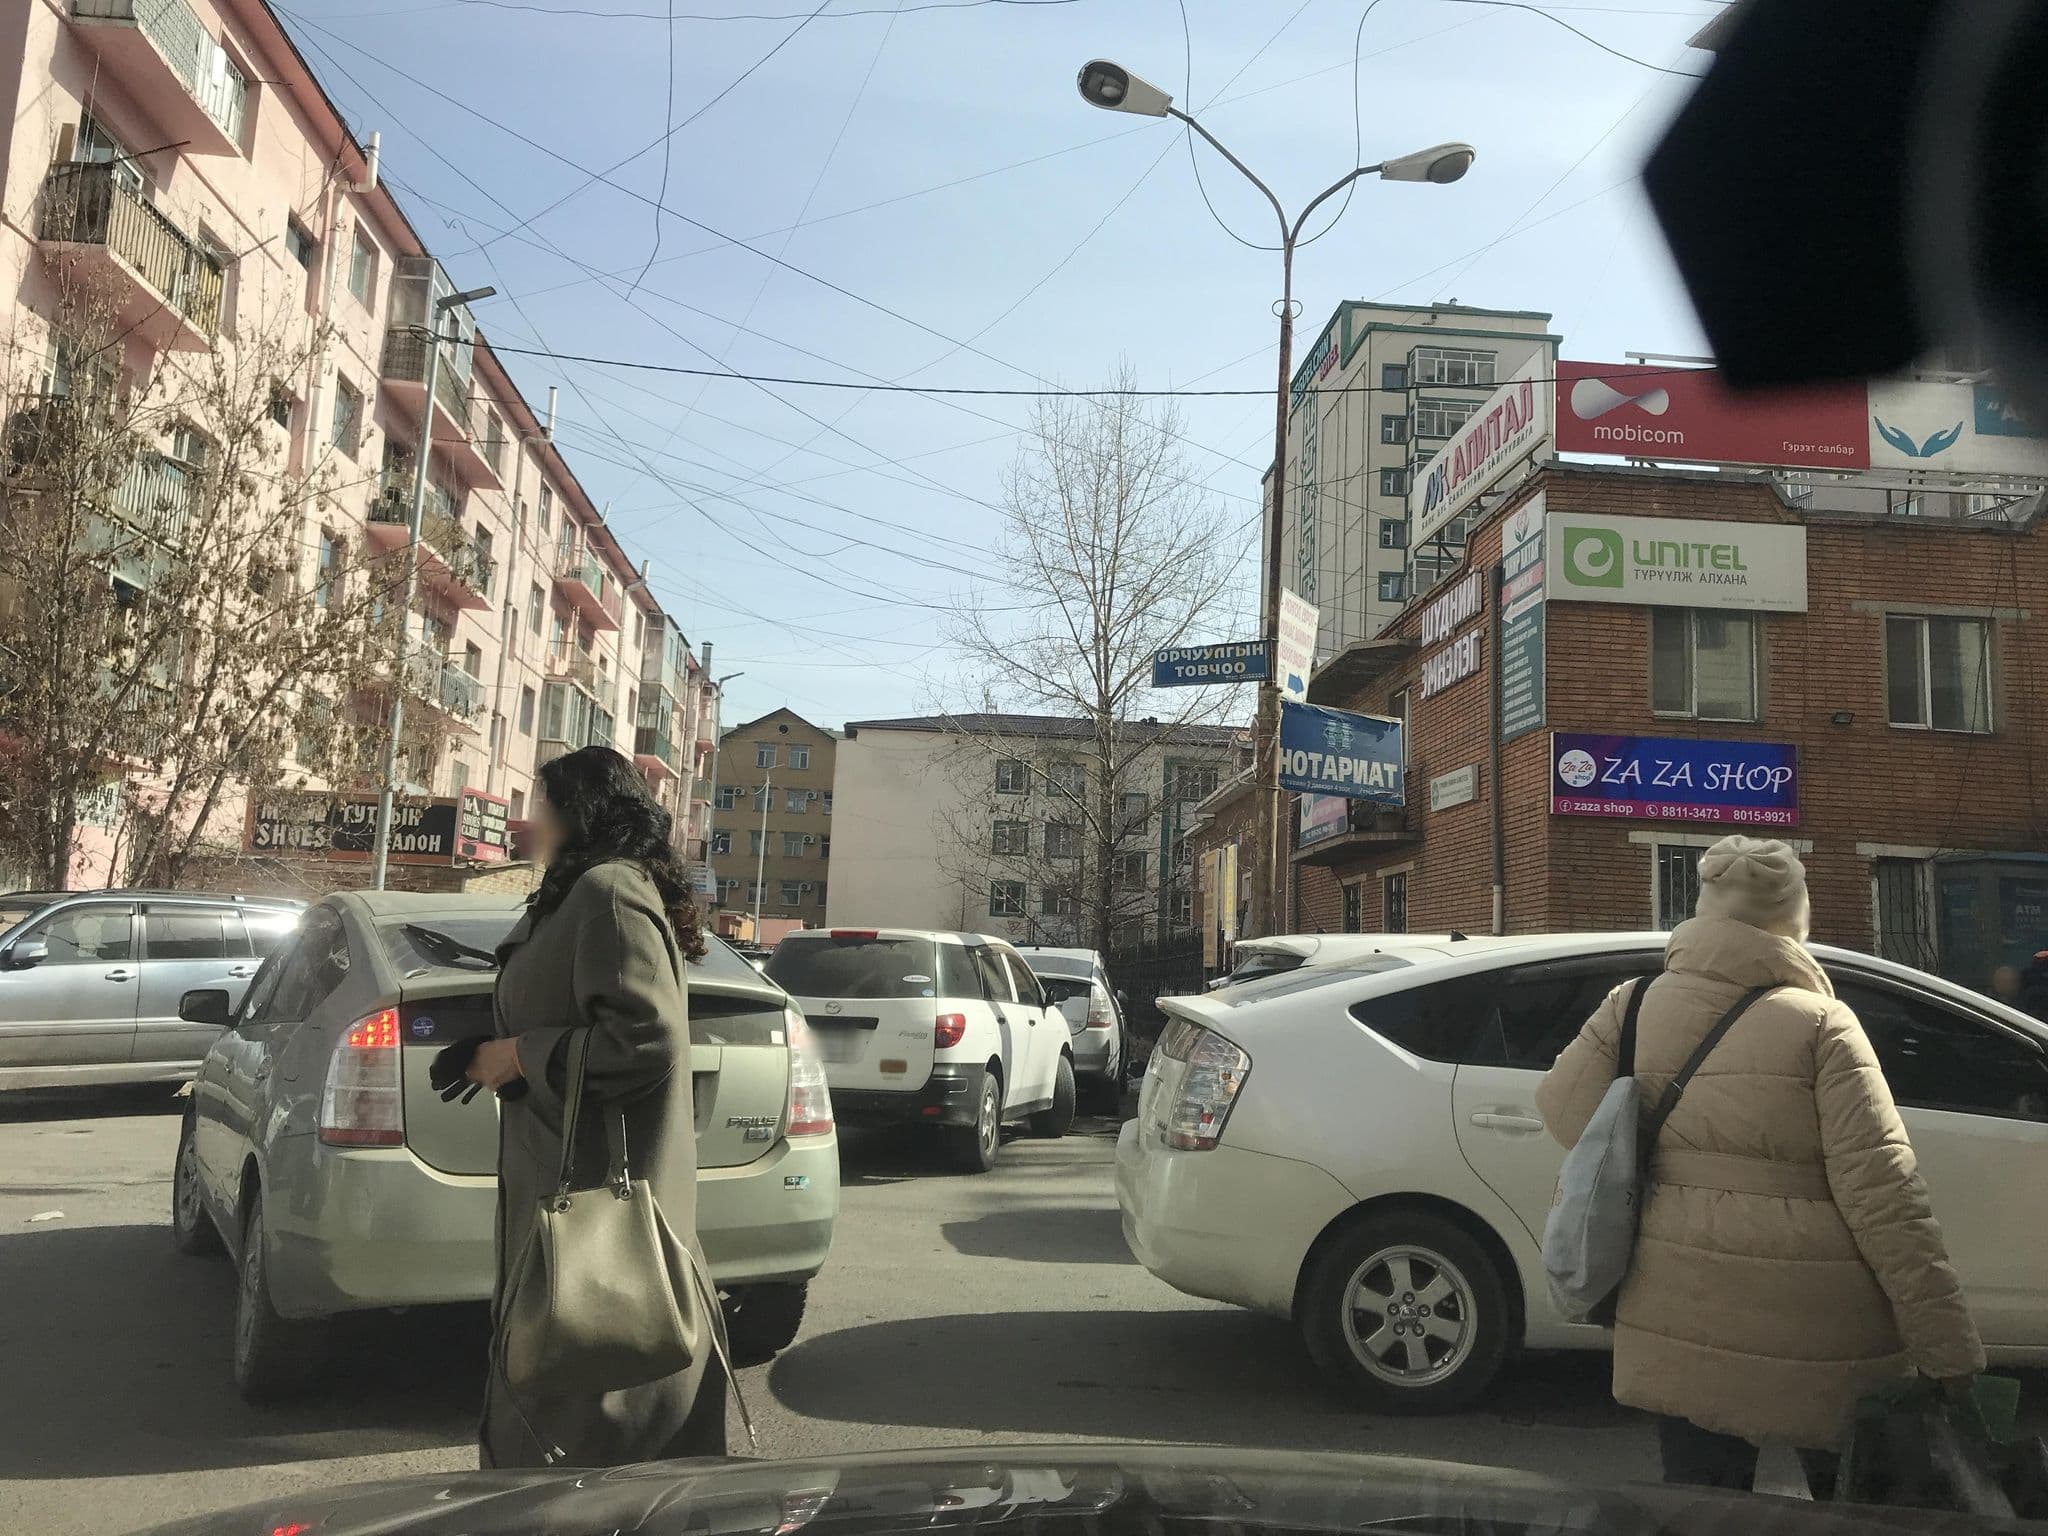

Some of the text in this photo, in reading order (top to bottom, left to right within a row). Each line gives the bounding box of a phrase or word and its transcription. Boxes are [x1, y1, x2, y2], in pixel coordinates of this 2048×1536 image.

[1594, 424, 1684, 444] mobicom
[1783, 441, 1855, 455] Гэрээт салбар
[1633, 540, 1747, 571] UNITEL
[1634, 569, 1747, 586] ТҮРҮҮЛЖ АЛХАНА
[1158, 643, 1264, 663] ОРЧУУЛГЫН
[1175, 661, 1247, 678] ТОВЧОО
[1280, 748, 1398, 789] НОТАРИАТ
[1601, 756, 1793, 794] ZA ZA SHOP
[343, 804, 422, 827] ГУТЫН
[1574, 801, 1633, 815] zaza shop
[1662, 807, 1792, 823] 8811-3473 8015-9921
[726, 1115, 780, 1128] PRIUS
